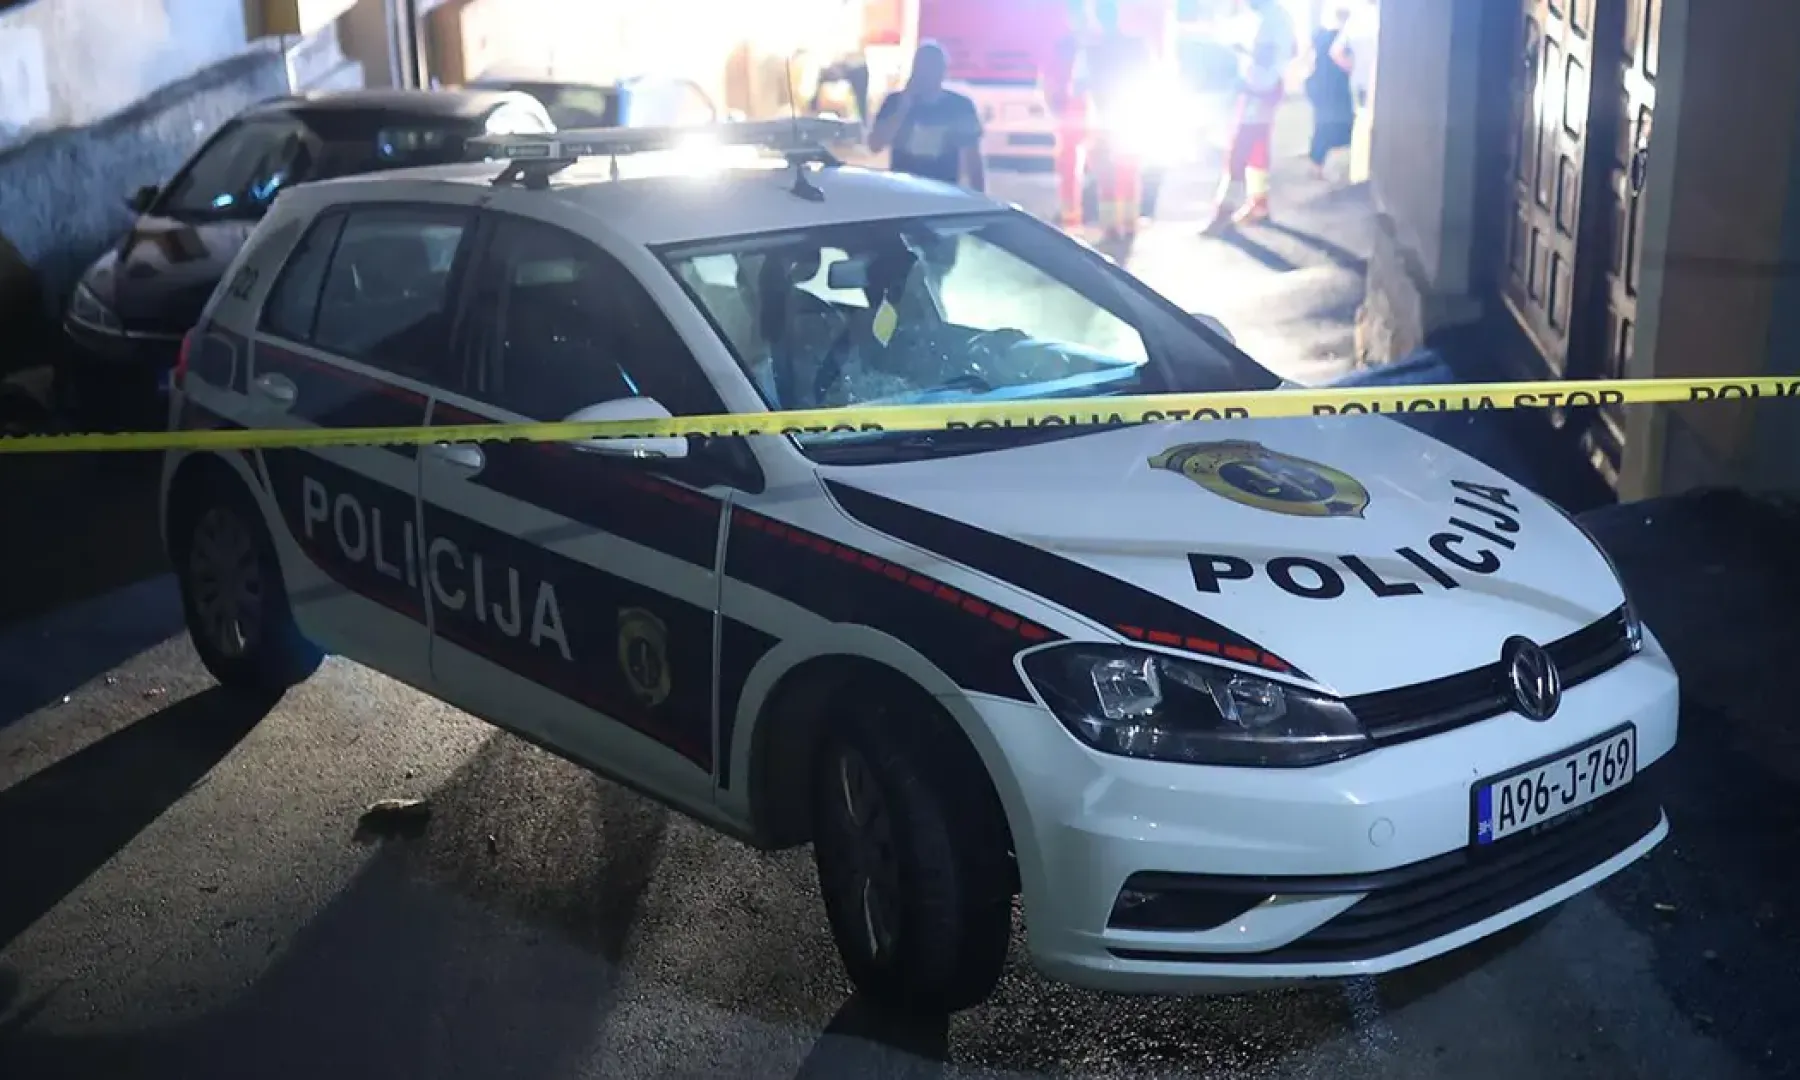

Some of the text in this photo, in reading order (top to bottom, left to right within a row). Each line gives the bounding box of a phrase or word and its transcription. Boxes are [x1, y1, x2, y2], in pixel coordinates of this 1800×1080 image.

[302, 475, 573, 661] POLICIJA
[1186, 479, 1520, 599] POLICIJA
[1500, 738, 1630, 831] A96-J-769
